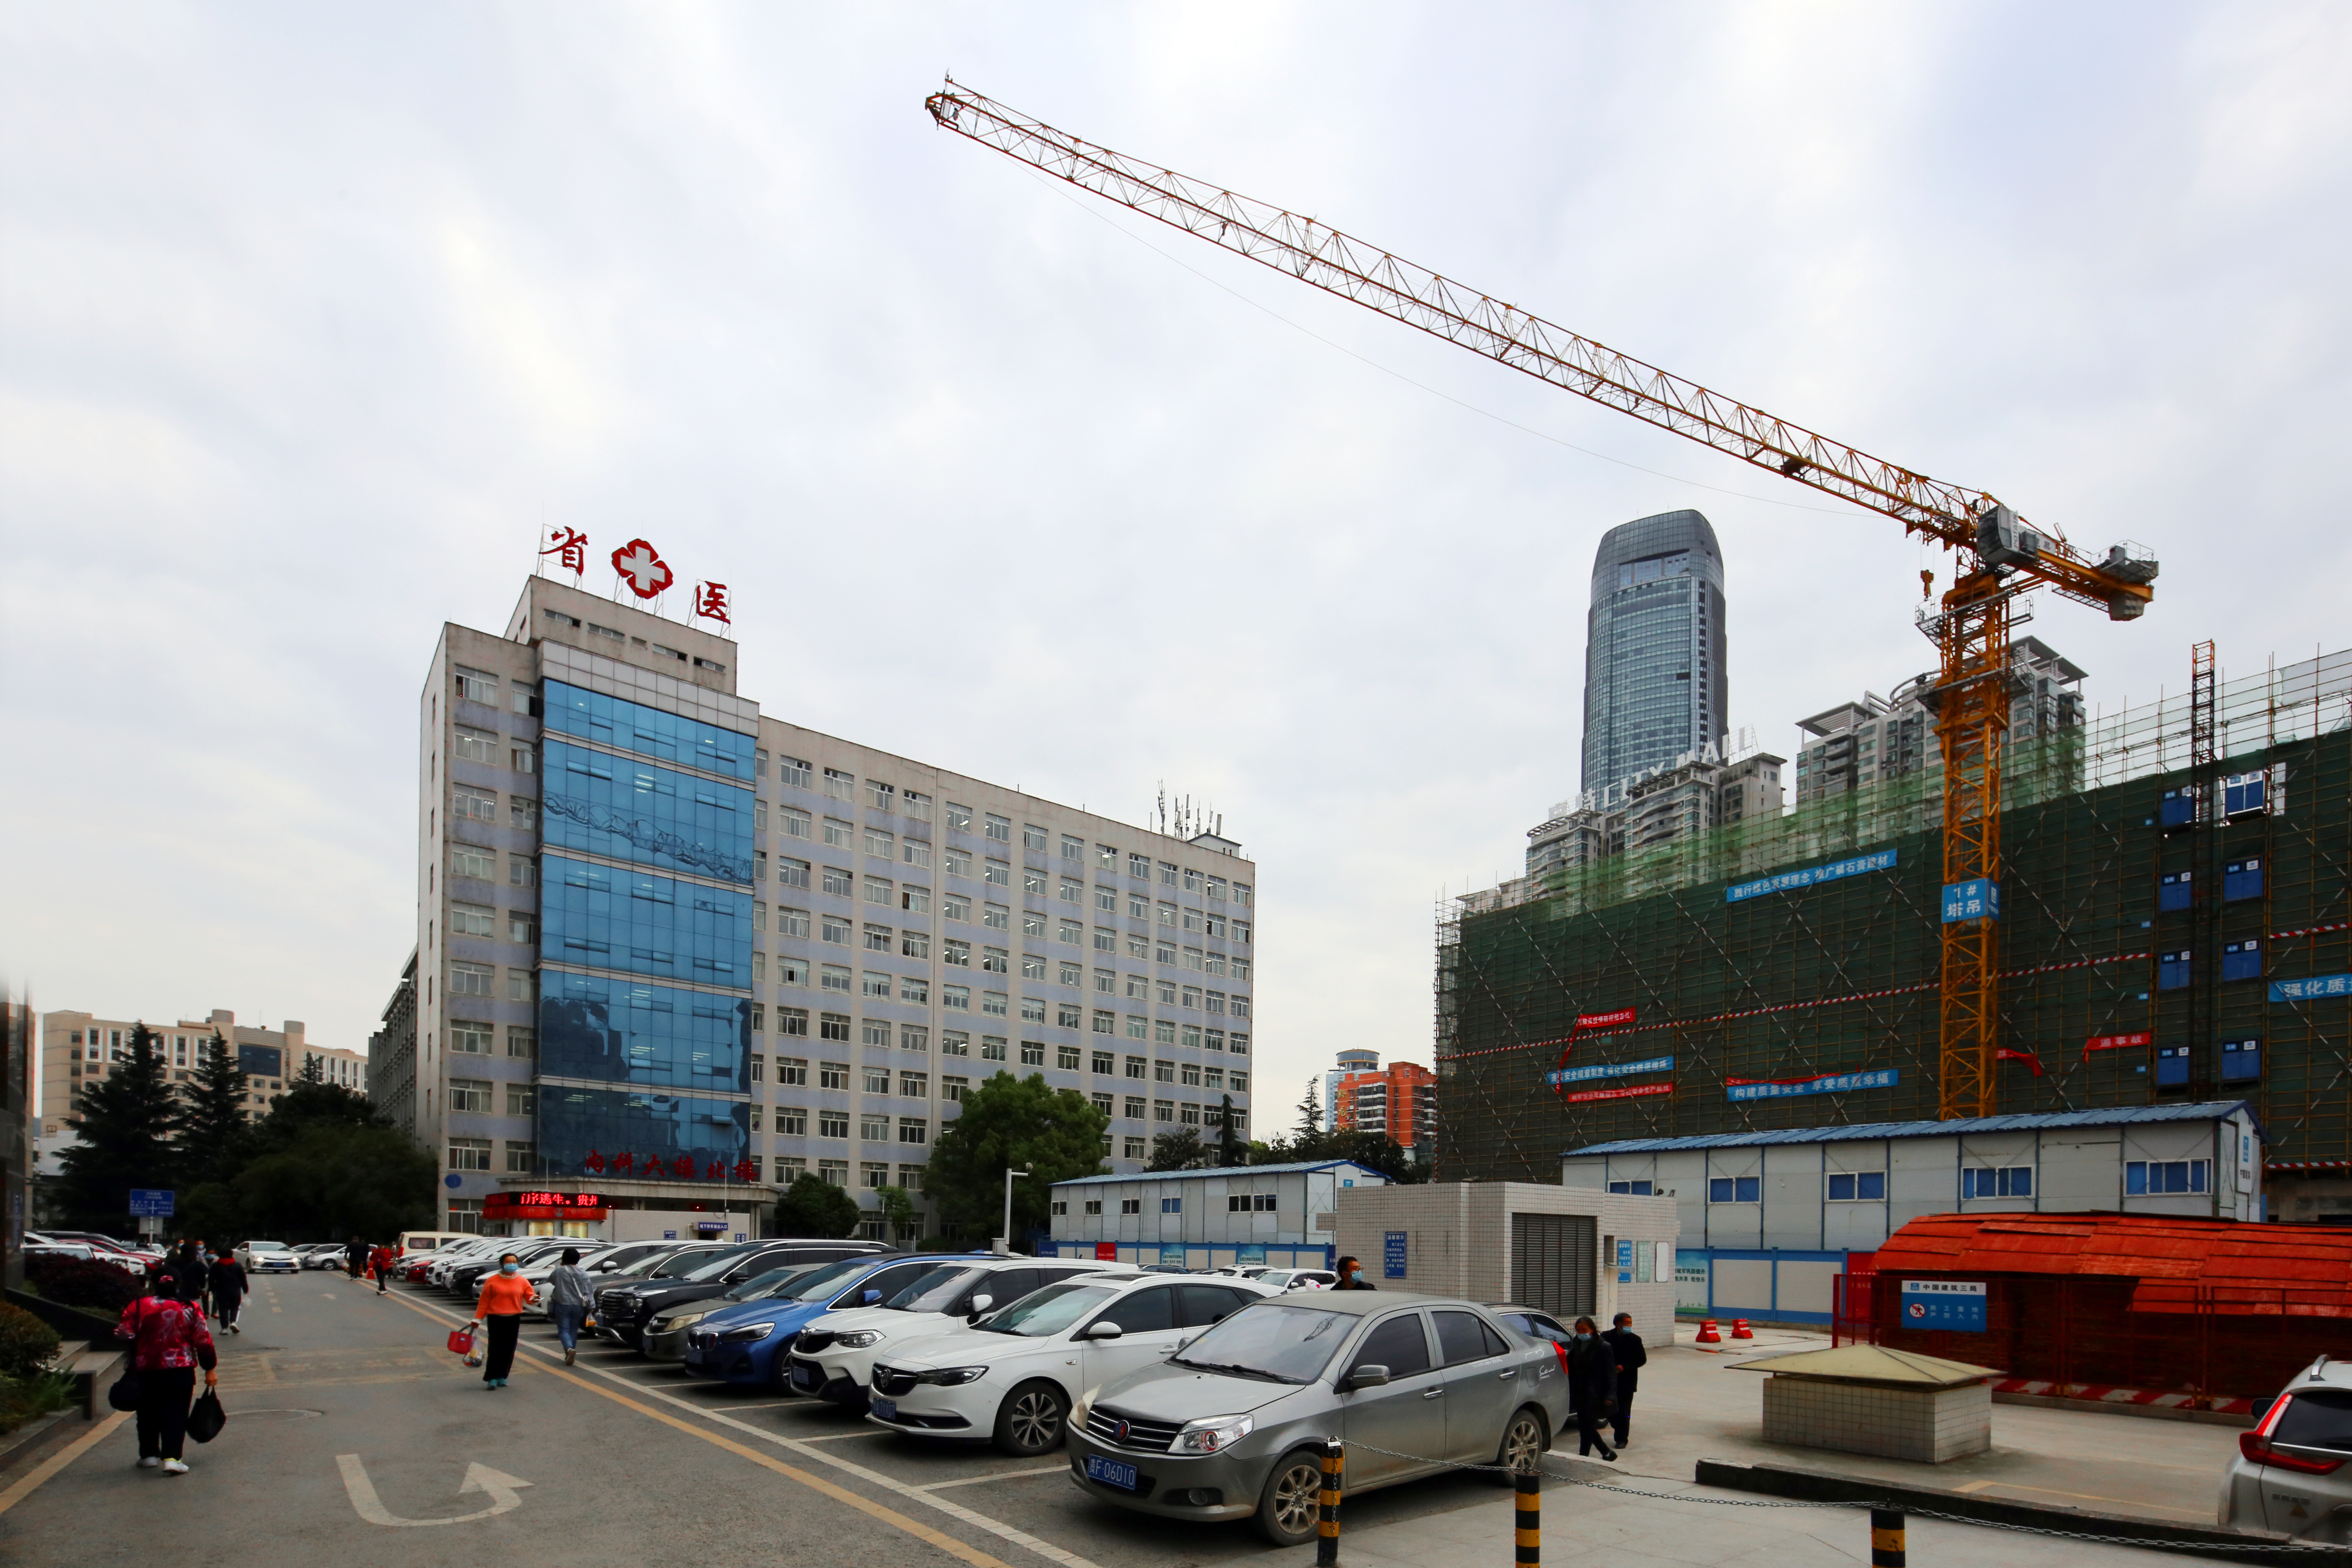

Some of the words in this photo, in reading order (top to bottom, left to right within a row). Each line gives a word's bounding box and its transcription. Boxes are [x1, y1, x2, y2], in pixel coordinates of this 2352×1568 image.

[1604, 761, 1665, 808] CITY
[1676, 726, 1753, 769] MALL
[1947, 899, 1981, 917] 塔吊
[2284, 977, 2352, 997] 强化质
[1735, 1083, 1804, 1098] 构建质量安全
[1812, 1073, 1889, 1091] 享受质量幸福
[586, 1149, 759, 1182] 内科大楼北楼
[1923, 1284, 1977, 1292] 中国建筑三局
